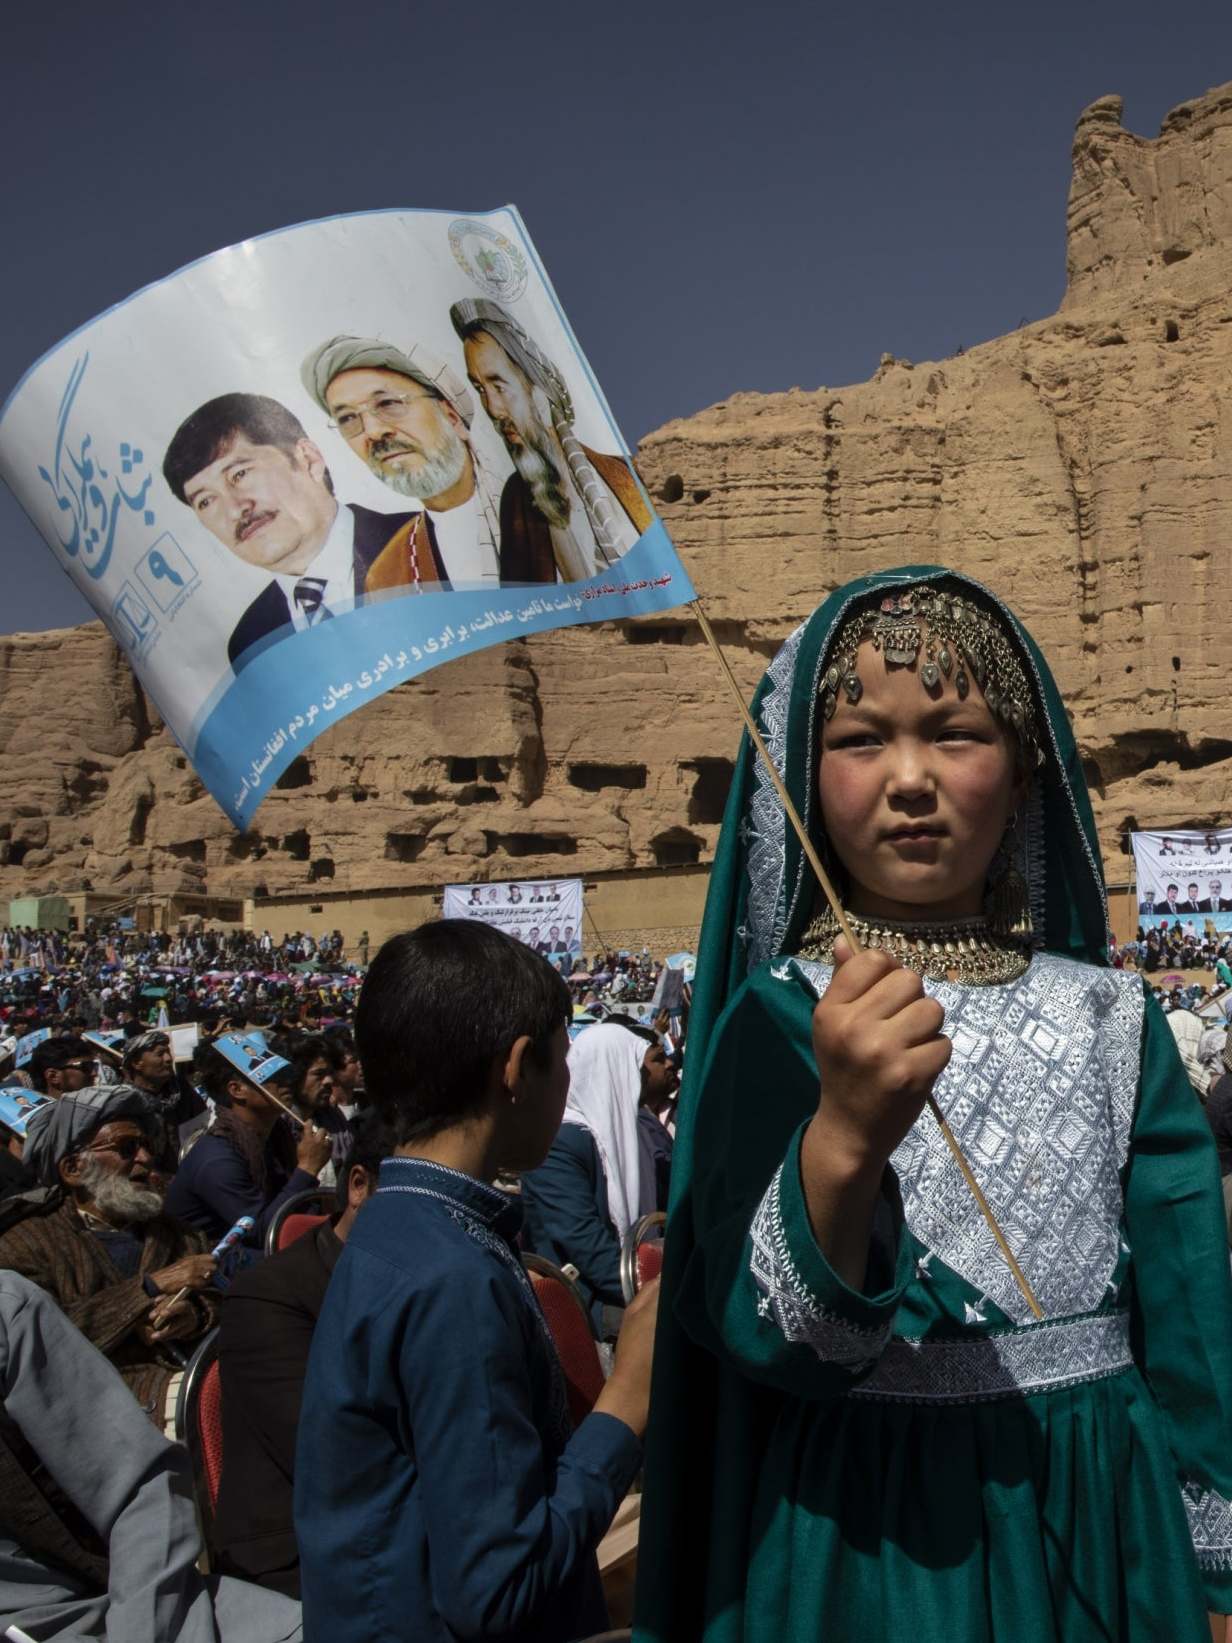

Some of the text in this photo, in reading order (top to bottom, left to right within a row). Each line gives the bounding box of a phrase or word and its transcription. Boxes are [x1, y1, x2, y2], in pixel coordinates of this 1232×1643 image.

[149, 550, 184, 587] ۹
[411, 646, 422, 661] و
[424, 625, 470, 653] برابری
[357, 651, 410, 689] برادری
[322, 683, 352, 711] میان
[289, 705, 320, 739] مردم
[249, 728, 288, 788] افغانستان
